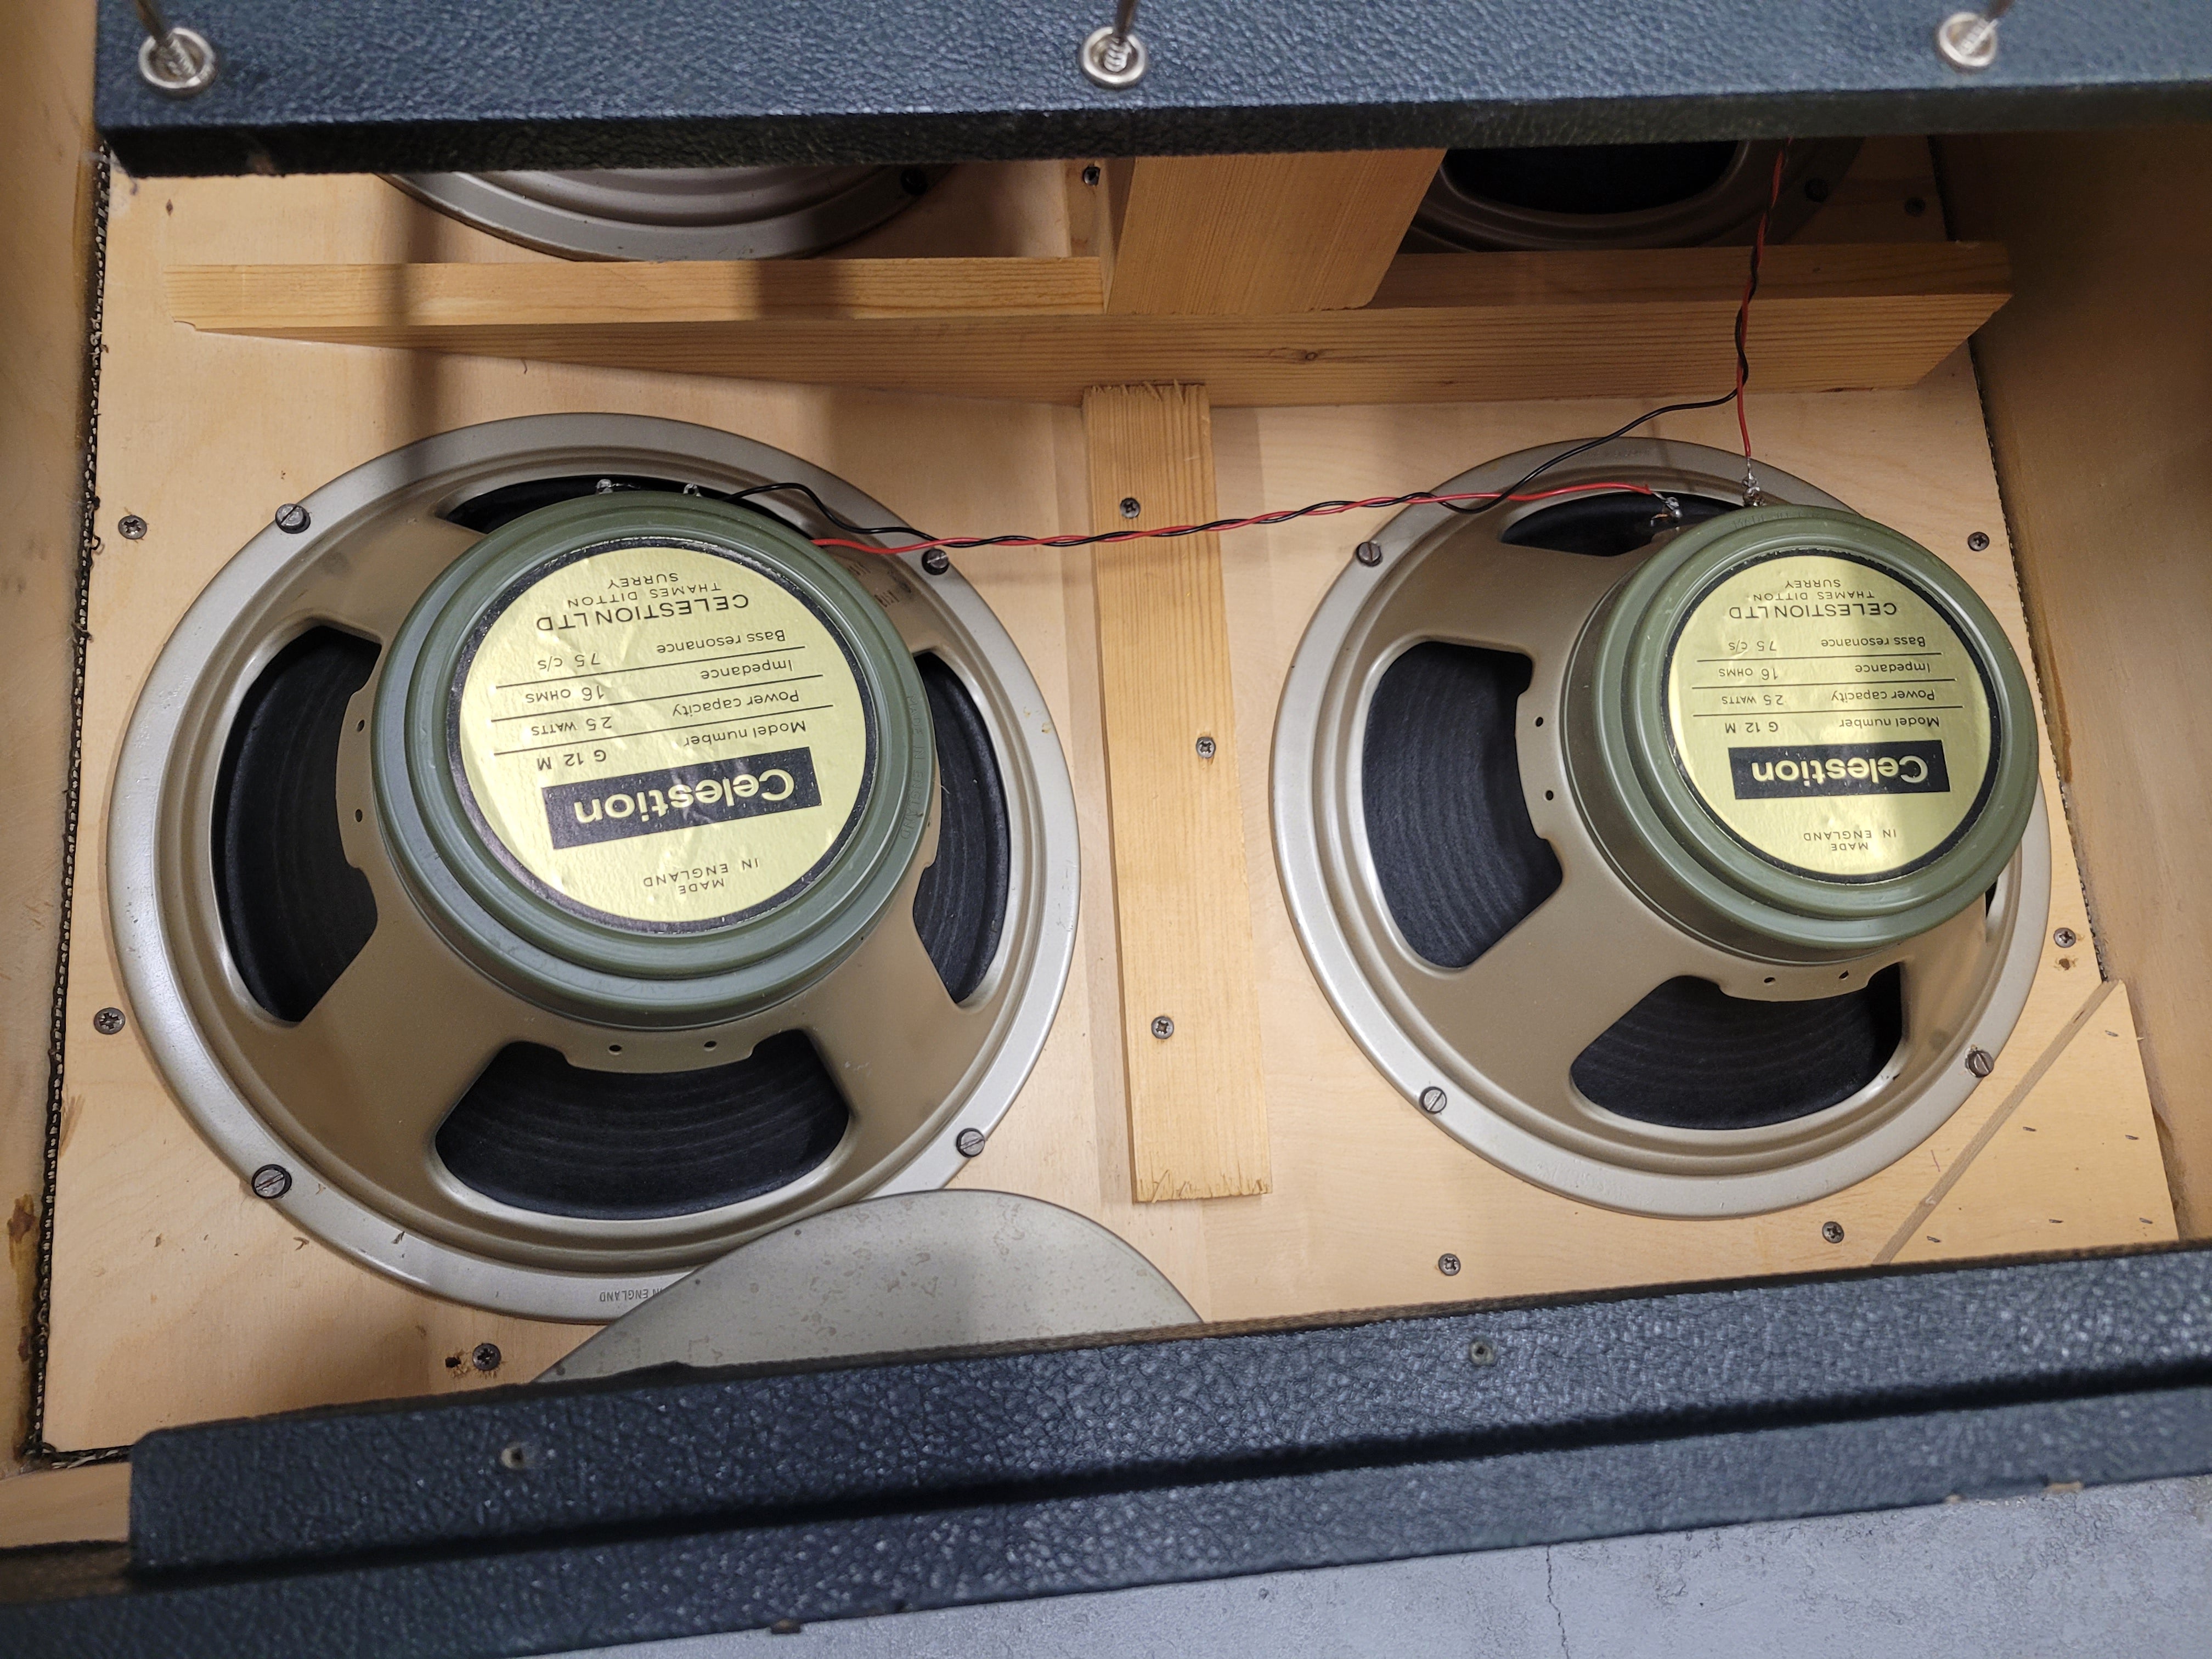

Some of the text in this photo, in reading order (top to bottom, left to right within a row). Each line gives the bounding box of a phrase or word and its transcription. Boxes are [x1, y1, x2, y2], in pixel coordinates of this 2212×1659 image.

[607, 572, 679, 589] SURREY
[1785, 579, 1841, 589] SURREY
[567, 583, 721, 608] THAMES DITTON
[1753, 590, 1875, 602] THAMES DITTON
[536, 594, 749, 631] CELESTION LTD
[1729, 602, 1897, 619] CELESTION LTD
[537, 629, 786, 672] Bass resonance 75 c/s
[1728, 636, 1926, 652] Bass resonance 75 c/s
[1718, 661, 1931, 680] Impedance 16 OHMS
[525, 659, 793, 703] Impedance 16 OHMS
[1721, 689, 1936, 706] Power capacity 25 WATTS
[531, 689, 799, 736] Power capacity 25 WATTS
[1725, 716, 1940, 734] Model number G 12 M
[537, 720, 806, 771] Model number G 12 M
[900, 695, 926, 840] MADE IN ENGLAND
[1751, 755, 1928, 787] Celestion
[573, 768, 795, 824] Celestion
[1803, 829, 1897, 841] IN ENGLAND
[1831, 842, 1869, 851] MADE
[644, 857, 759, 888] IN ENGLAND
[679, 878, 725, 895] MADE
[599, 1289, 649, 1302] ENGLAND
